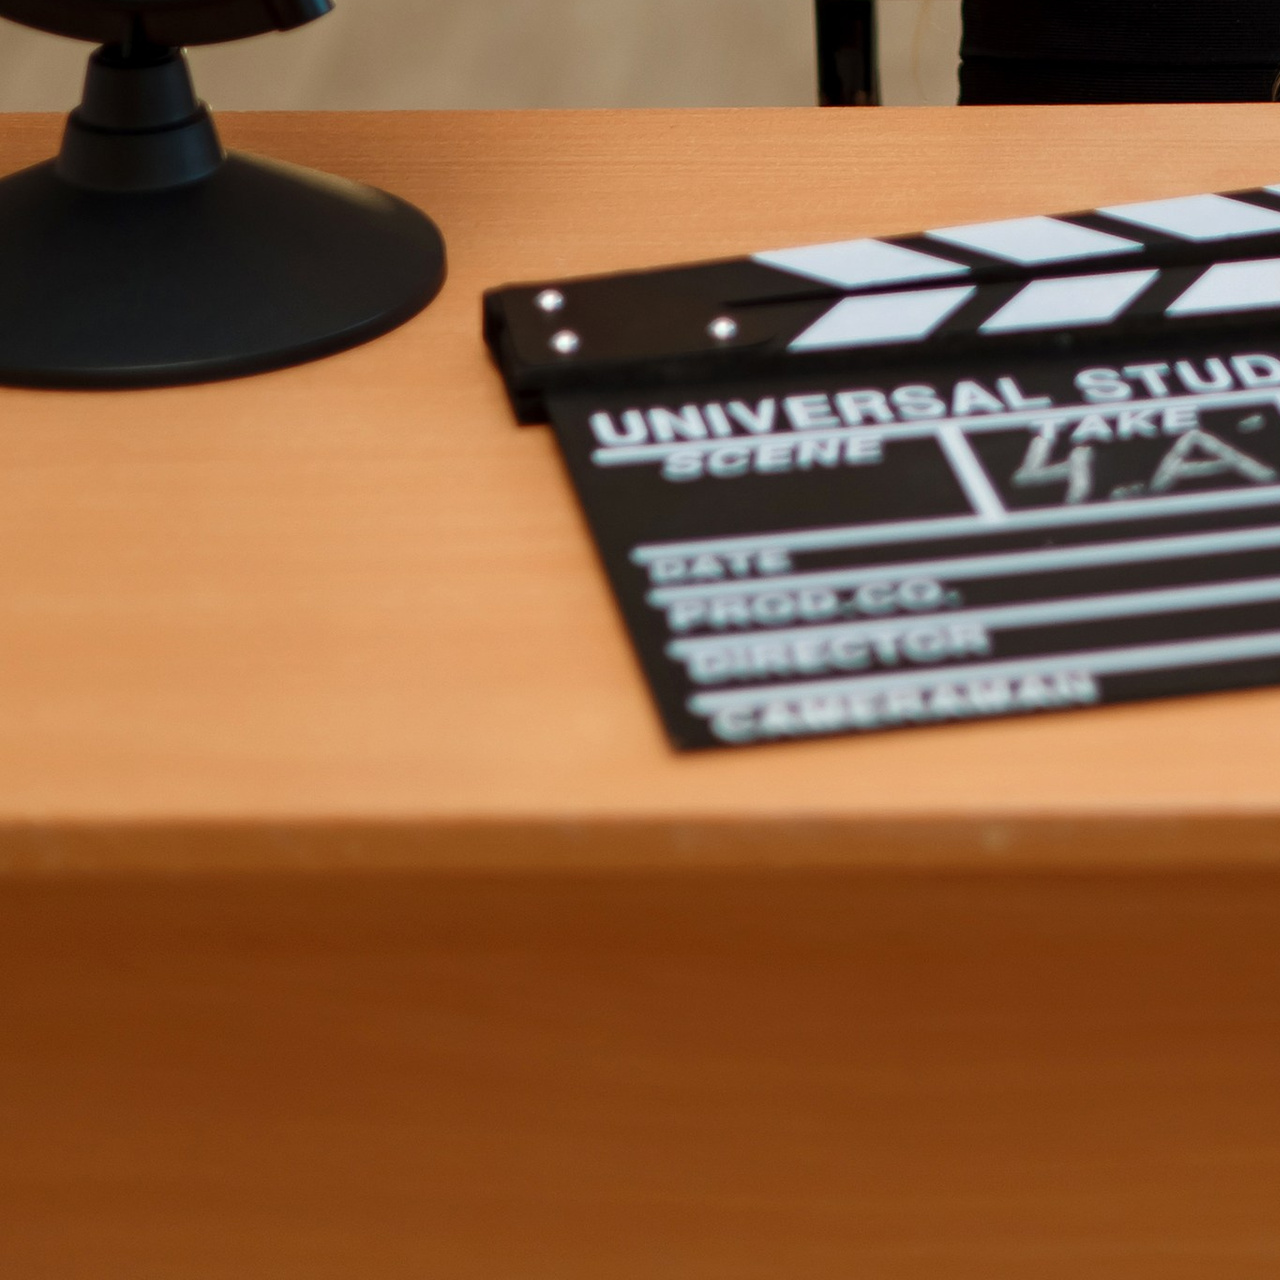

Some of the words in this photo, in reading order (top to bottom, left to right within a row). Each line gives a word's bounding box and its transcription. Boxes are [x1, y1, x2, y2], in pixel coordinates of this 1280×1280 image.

[590, 376, 1052, 447] UNIVERSAL
[1030, 404, 1200, 442] TAKE
[662, 435, 884, 481] SCENE
[650, 548, 794, 583] DATE
[686, 622, 992, 685] DIRECTOR
[711, 670, 1098, 744] CAMERAMAN
